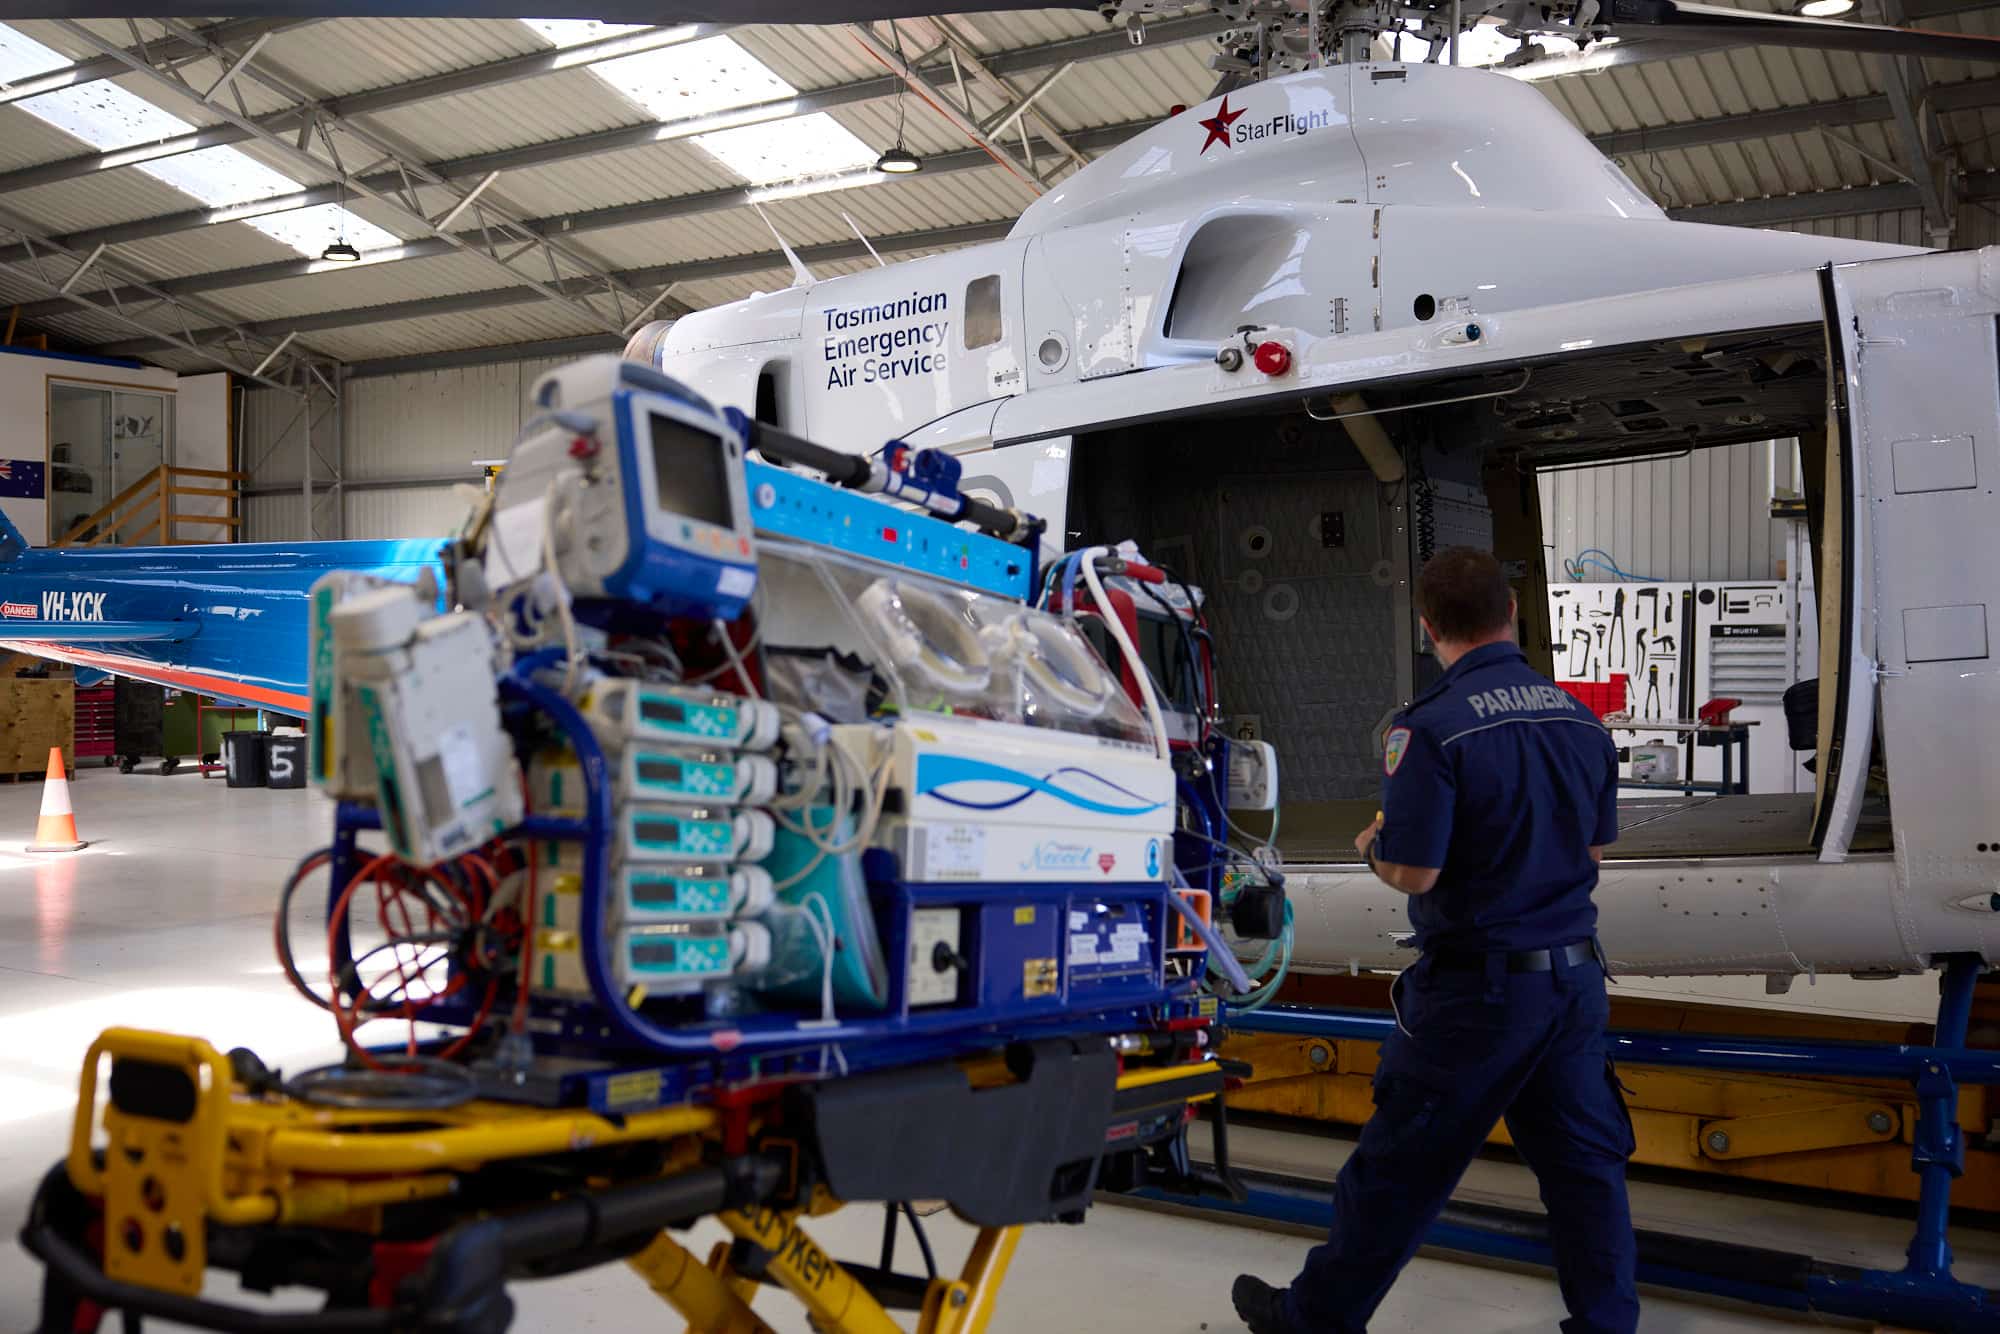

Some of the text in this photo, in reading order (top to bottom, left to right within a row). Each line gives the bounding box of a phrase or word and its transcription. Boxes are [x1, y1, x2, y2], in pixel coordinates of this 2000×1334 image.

[1236, 109, 1329, 143] StarFlight
[823, 291, 948, 332] Tasmanian
[824, 321, 949, 361] Emergency
[827, 349, 947, 390] Air Service
[4, 605, 37, 616] DANGER
[42, 591, 107, 621] VH-XCK
[269, 744, 296, 779] 5
